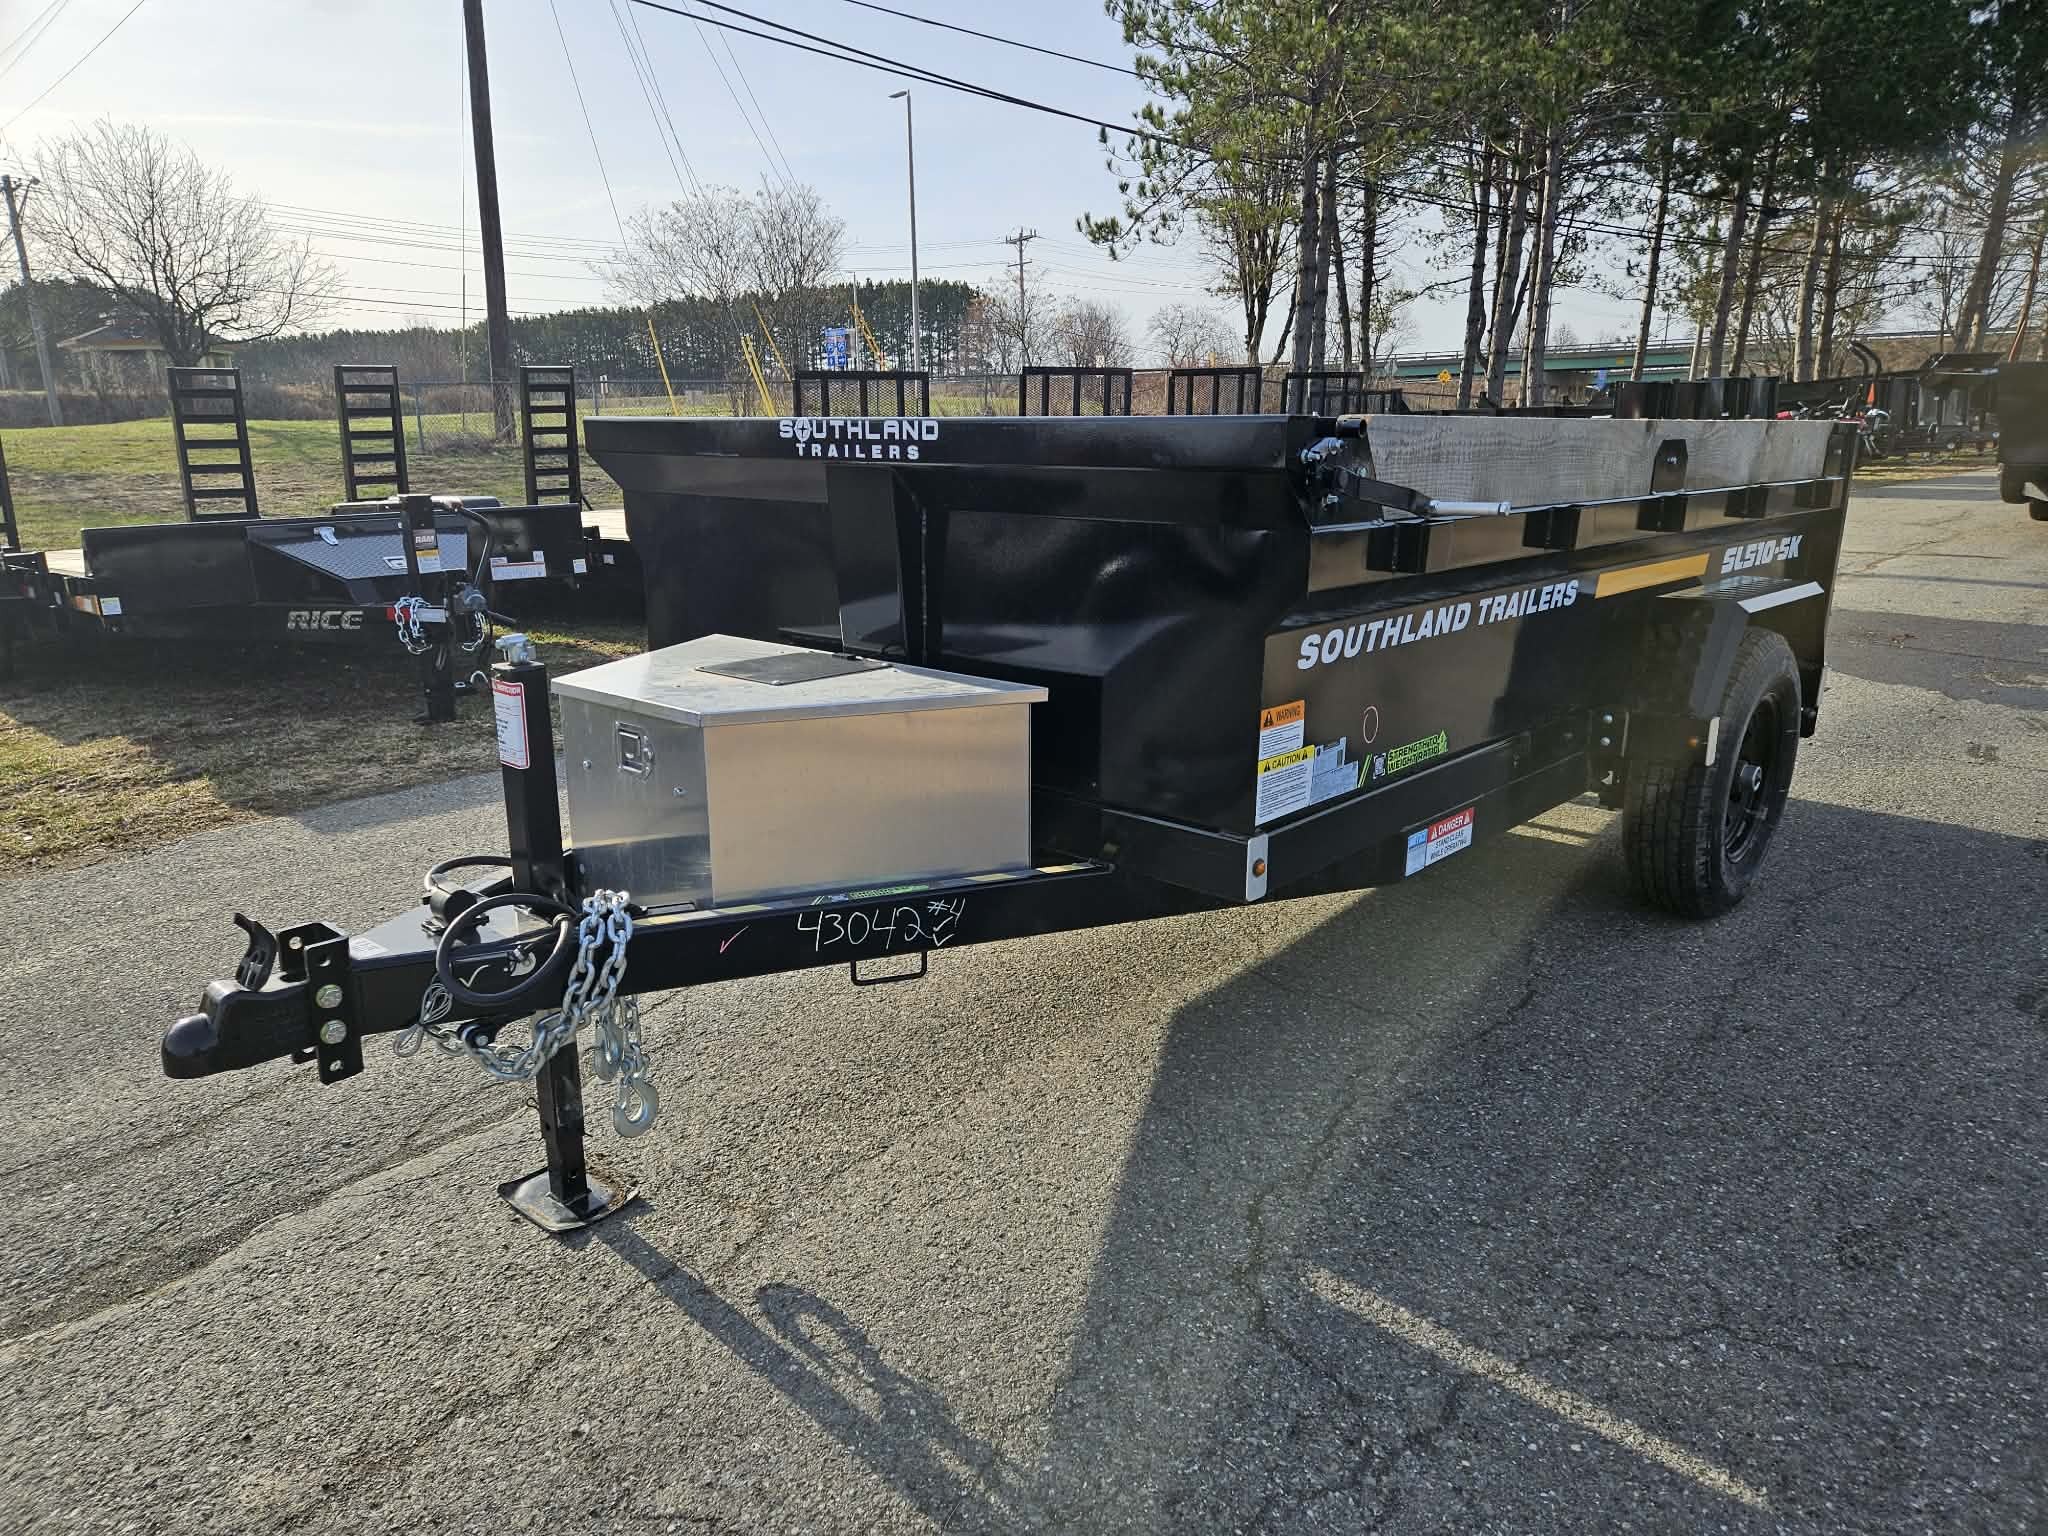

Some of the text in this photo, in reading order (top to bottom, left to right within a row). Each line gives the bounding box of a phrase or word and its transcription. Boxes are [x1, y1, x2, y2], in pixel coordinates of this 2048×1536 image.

[779, 417, 939, 441] SOUTHLAND
[796, 442, 920, 460] TRAILERS
[415, 535, 435, 544] RAM
[287, 610, 364, 630] RICE
[1297, 579, 1580, 670] SOUTHLAND TRAILERS
[1275, 705, 1302, 722] WARNING
[1272, 753, 1301, 770] CAUTION
[1438, 815, 1464, 836] DANGER
[796, 897, 966, 952] 43042 #4
